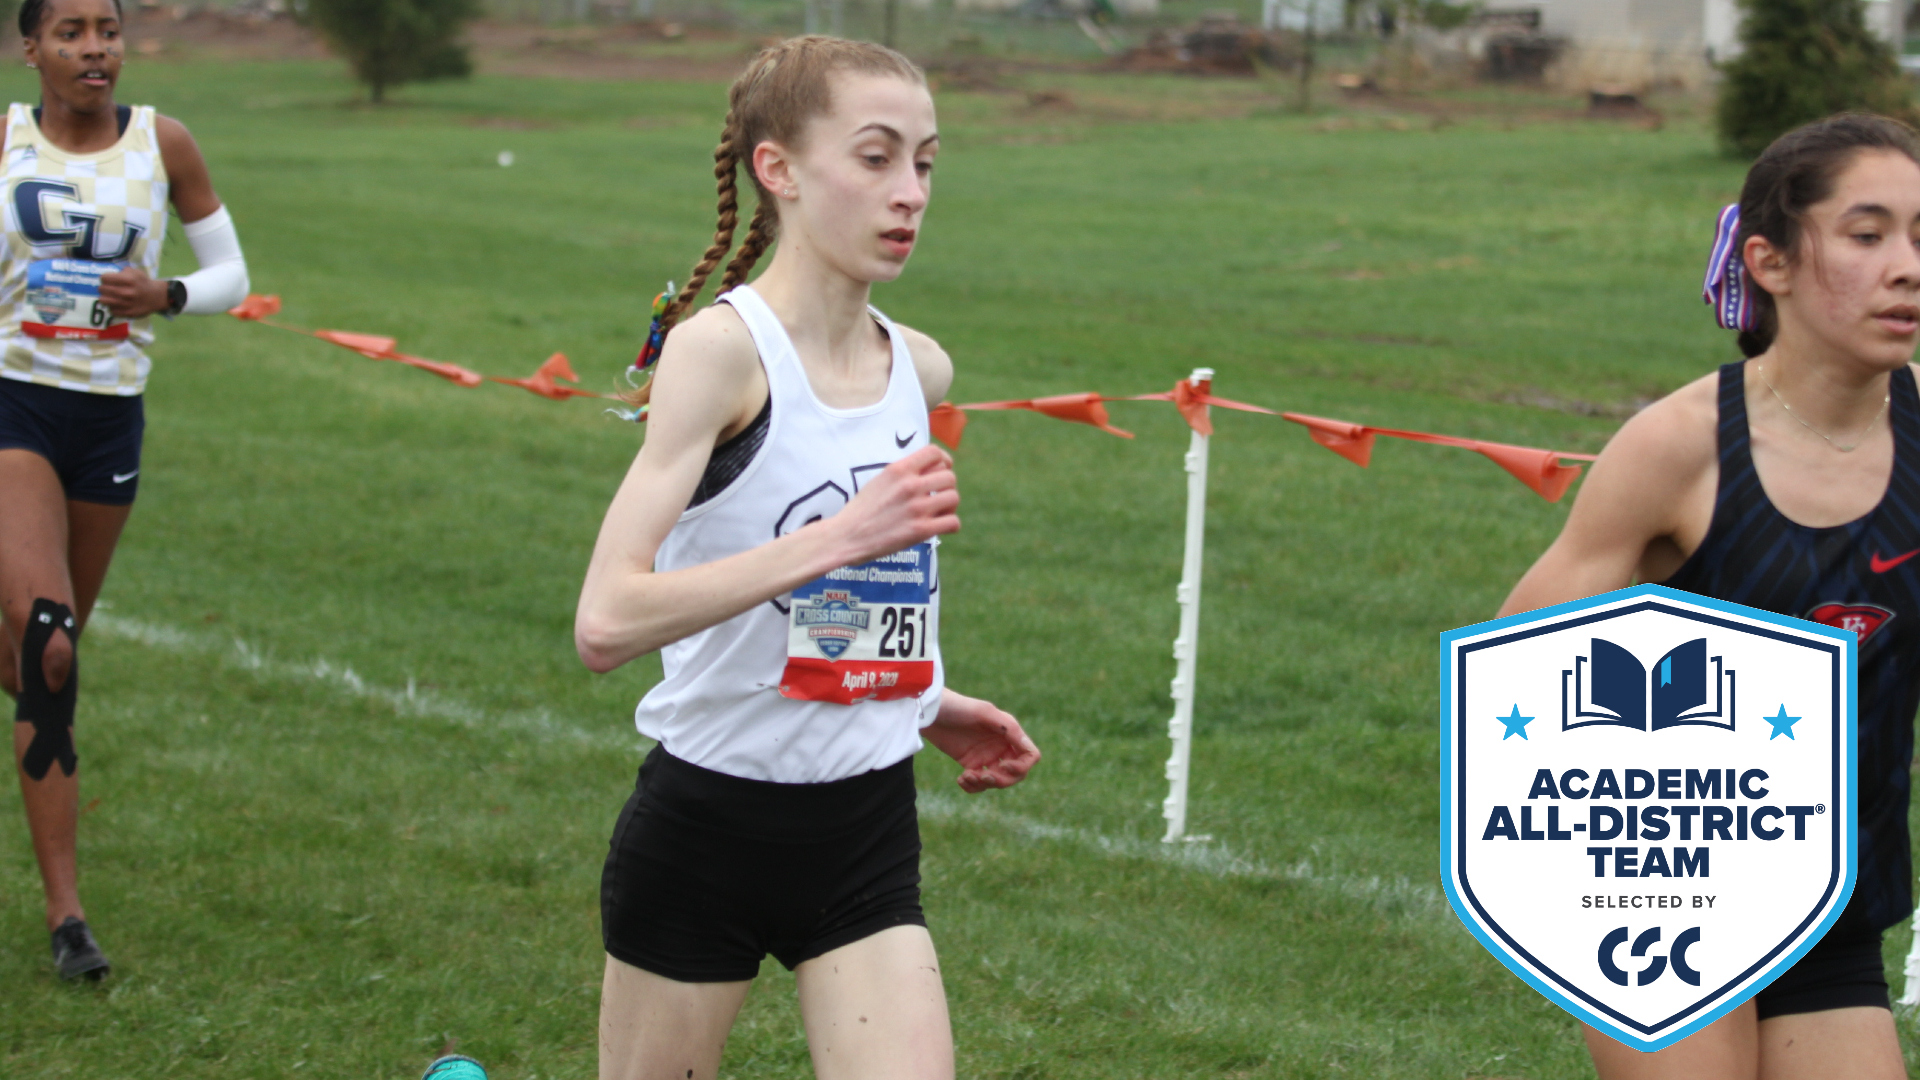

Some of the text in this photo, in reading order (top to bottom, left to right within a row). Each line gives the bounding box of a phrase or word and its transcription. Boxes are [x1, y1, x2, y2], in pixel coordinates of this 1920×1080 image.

[825, 566, 868, 581] National
[826, 592, 848, 602] NAIA
[797, 608, 869, 627] CROSS COUNTRY
[878, 606, 927, 659] 251
[841, 671, 868, 692] April
